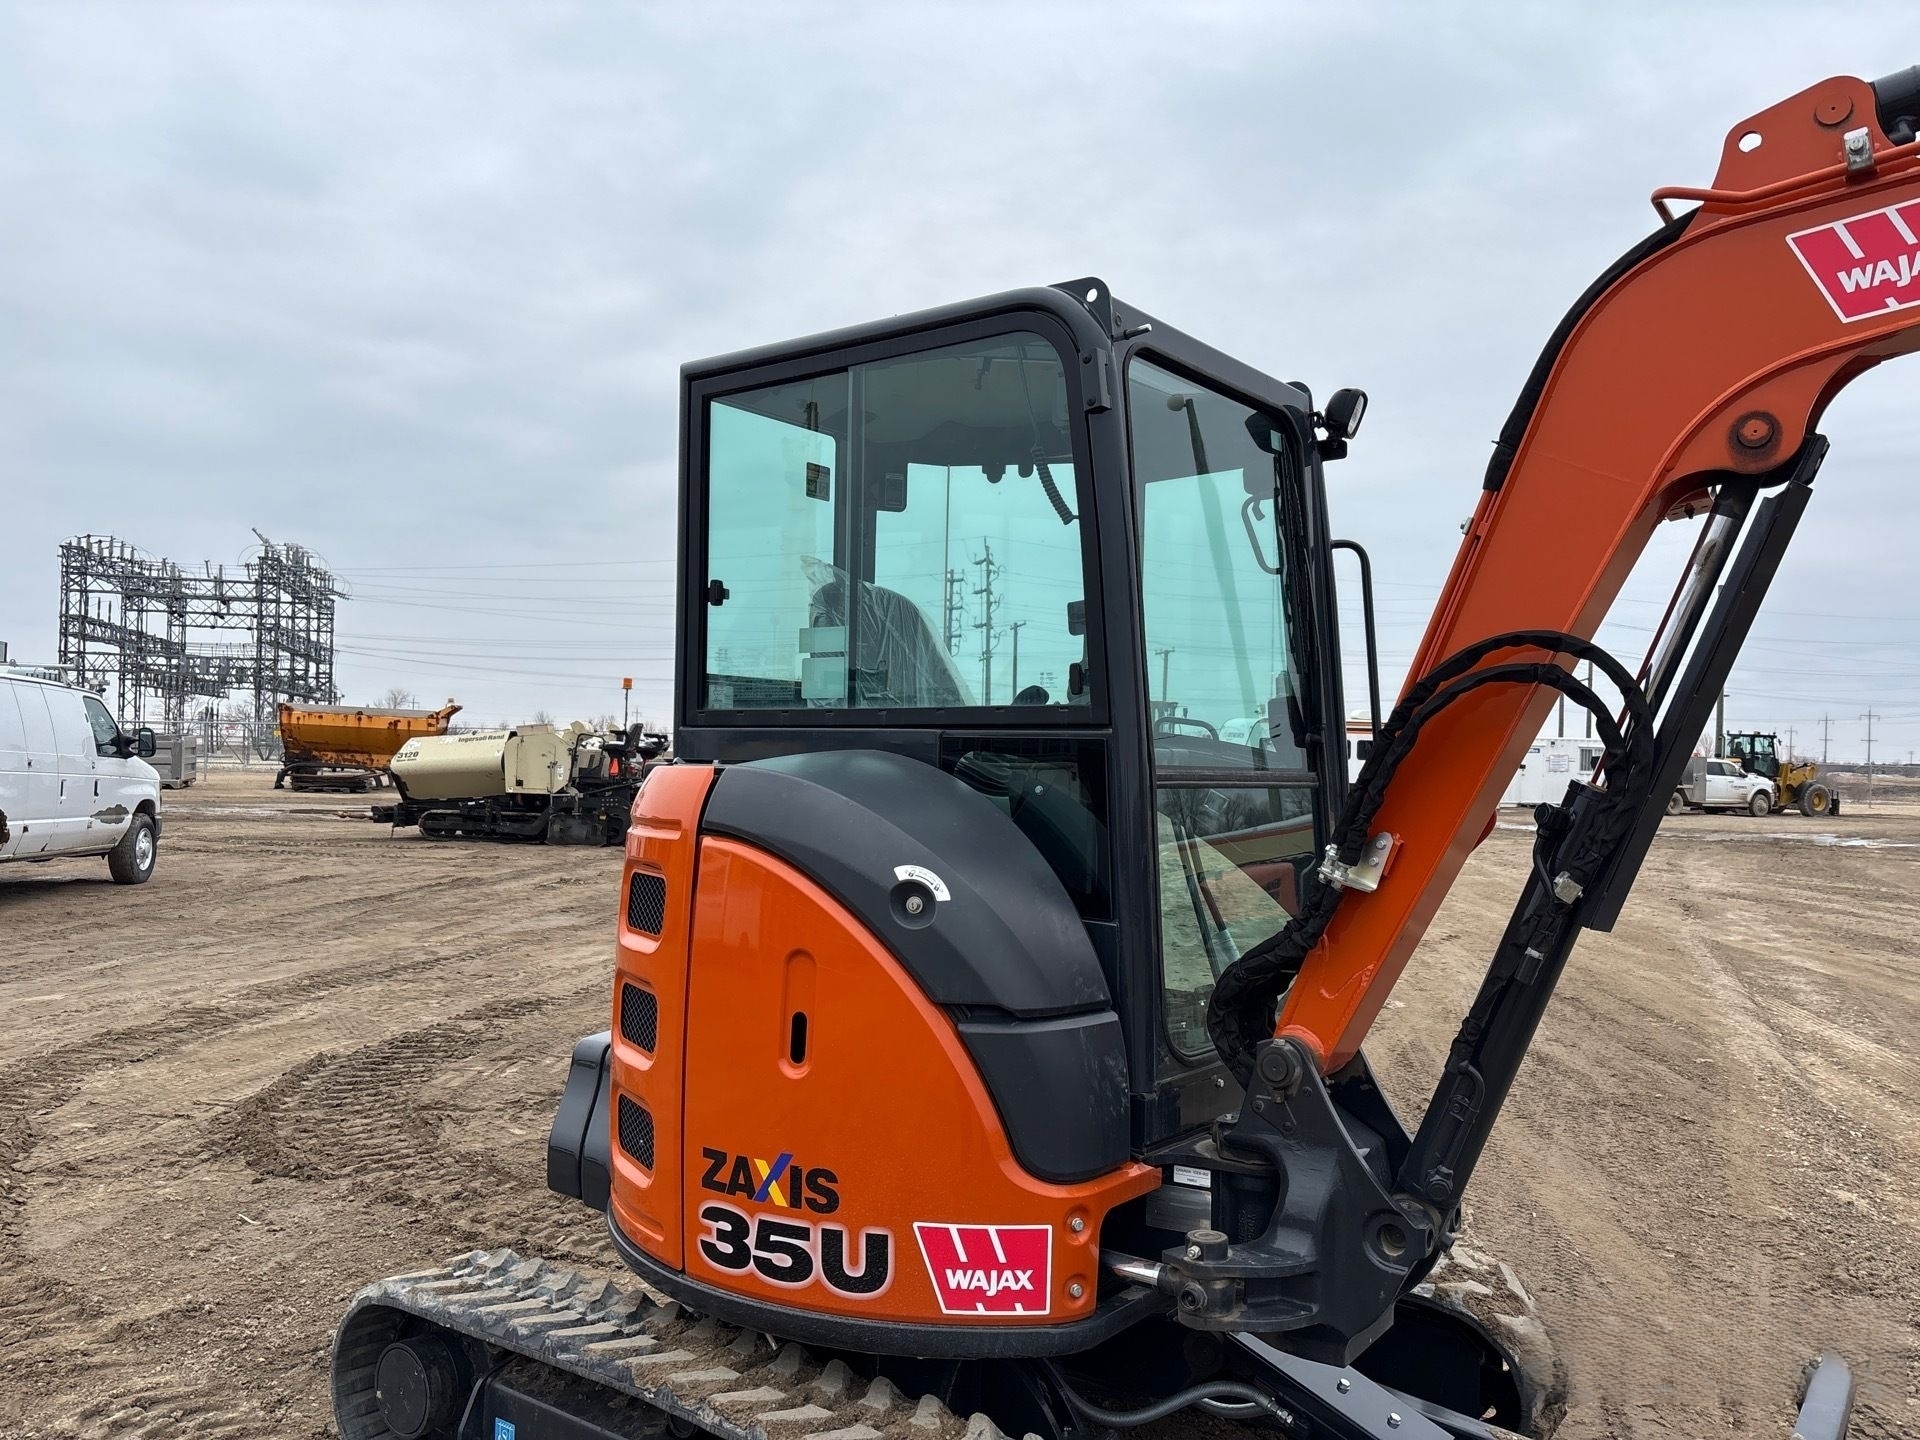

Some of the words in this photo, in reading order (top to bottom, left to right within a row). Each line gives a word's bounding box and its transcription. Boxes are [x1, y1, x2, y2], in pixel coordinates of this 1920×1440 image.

[397, 751, 419, 759] 3120
[701, 1146, 840, 1214] ZAXIS
[699, 1205, 890, 1295] 35U
[944, 1268, 1035, 1297] WAJAX
